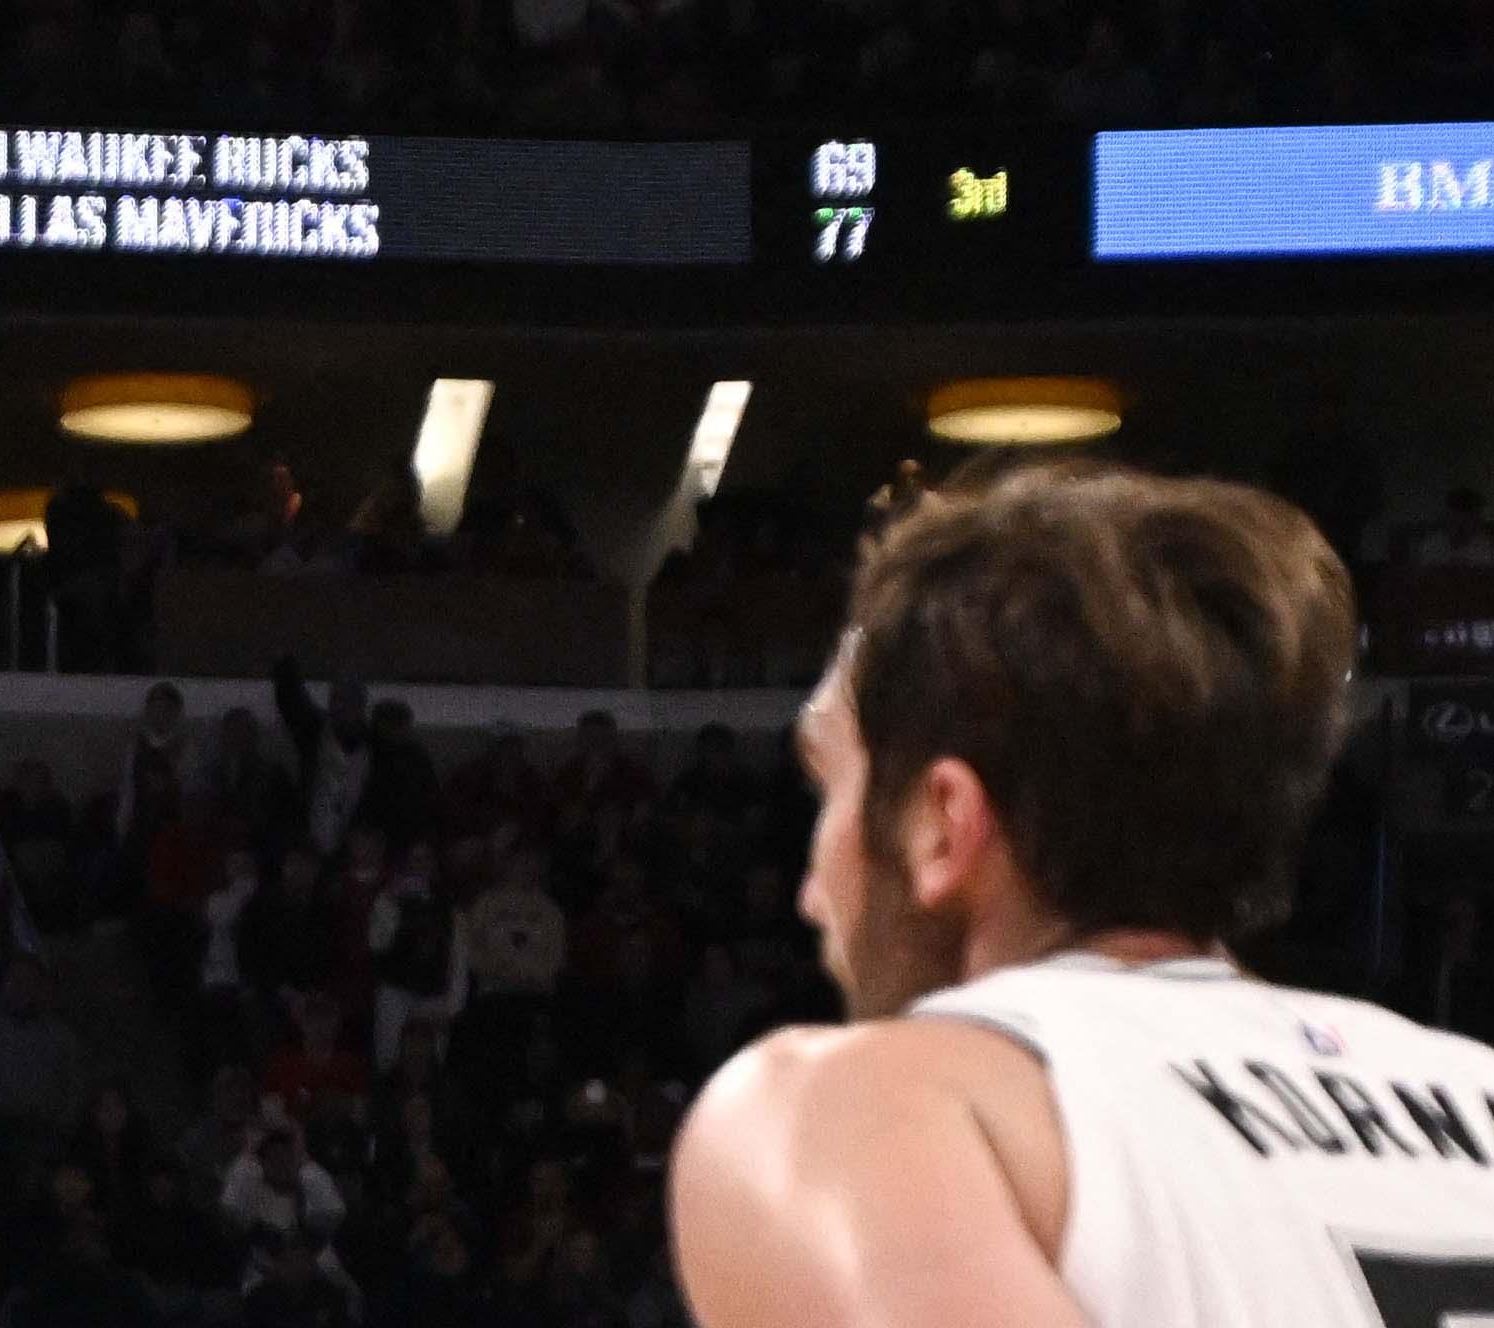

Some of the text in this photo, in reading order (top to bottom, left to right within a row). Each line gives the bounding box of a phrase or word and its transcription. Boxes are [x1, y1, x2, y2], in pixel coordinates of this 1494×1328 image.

[947, 167, 1008, 221] 3rd
[813, 206, 876, 263] 77
[1168, 1056, 1494, 1168] KORN
